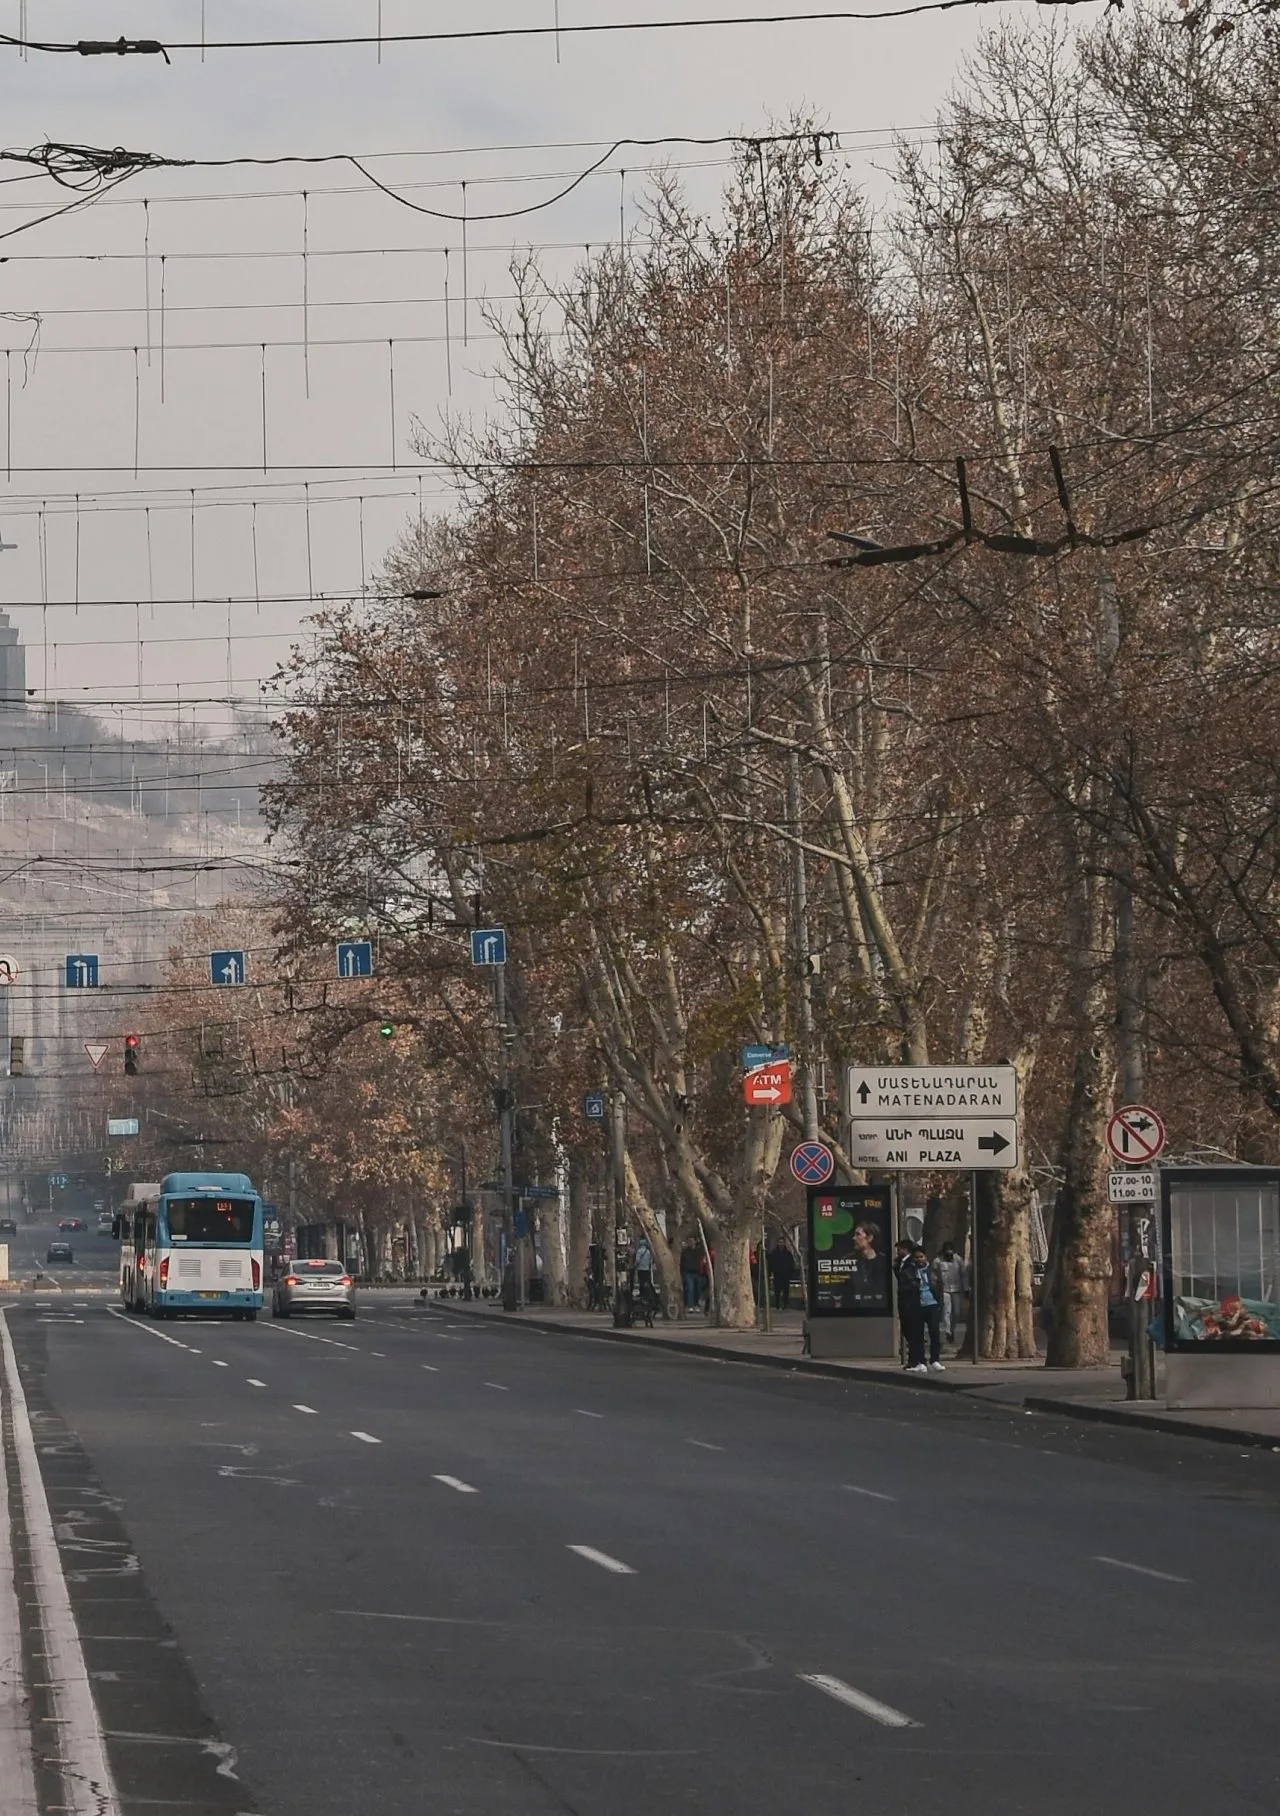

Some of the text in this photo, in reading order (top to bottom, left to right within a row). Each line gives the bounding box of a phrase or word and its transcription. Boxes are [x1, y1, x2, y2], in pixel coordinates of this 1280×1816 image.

[753, 1075, 781, 1085] ATM
[878, 1077, 998, 1089] ՄԱՏԵՆԱԴԱՐԱՆ
[878, 1093, 1002, 1106] MATENADARAN
[886, 1128, 912, 1141] ԱՆԻ
[918, 1128, 964, 1141] ՊԼԱԶԱ
[858, 1150, 962, 1163] HOTEL ANI PLAZA
